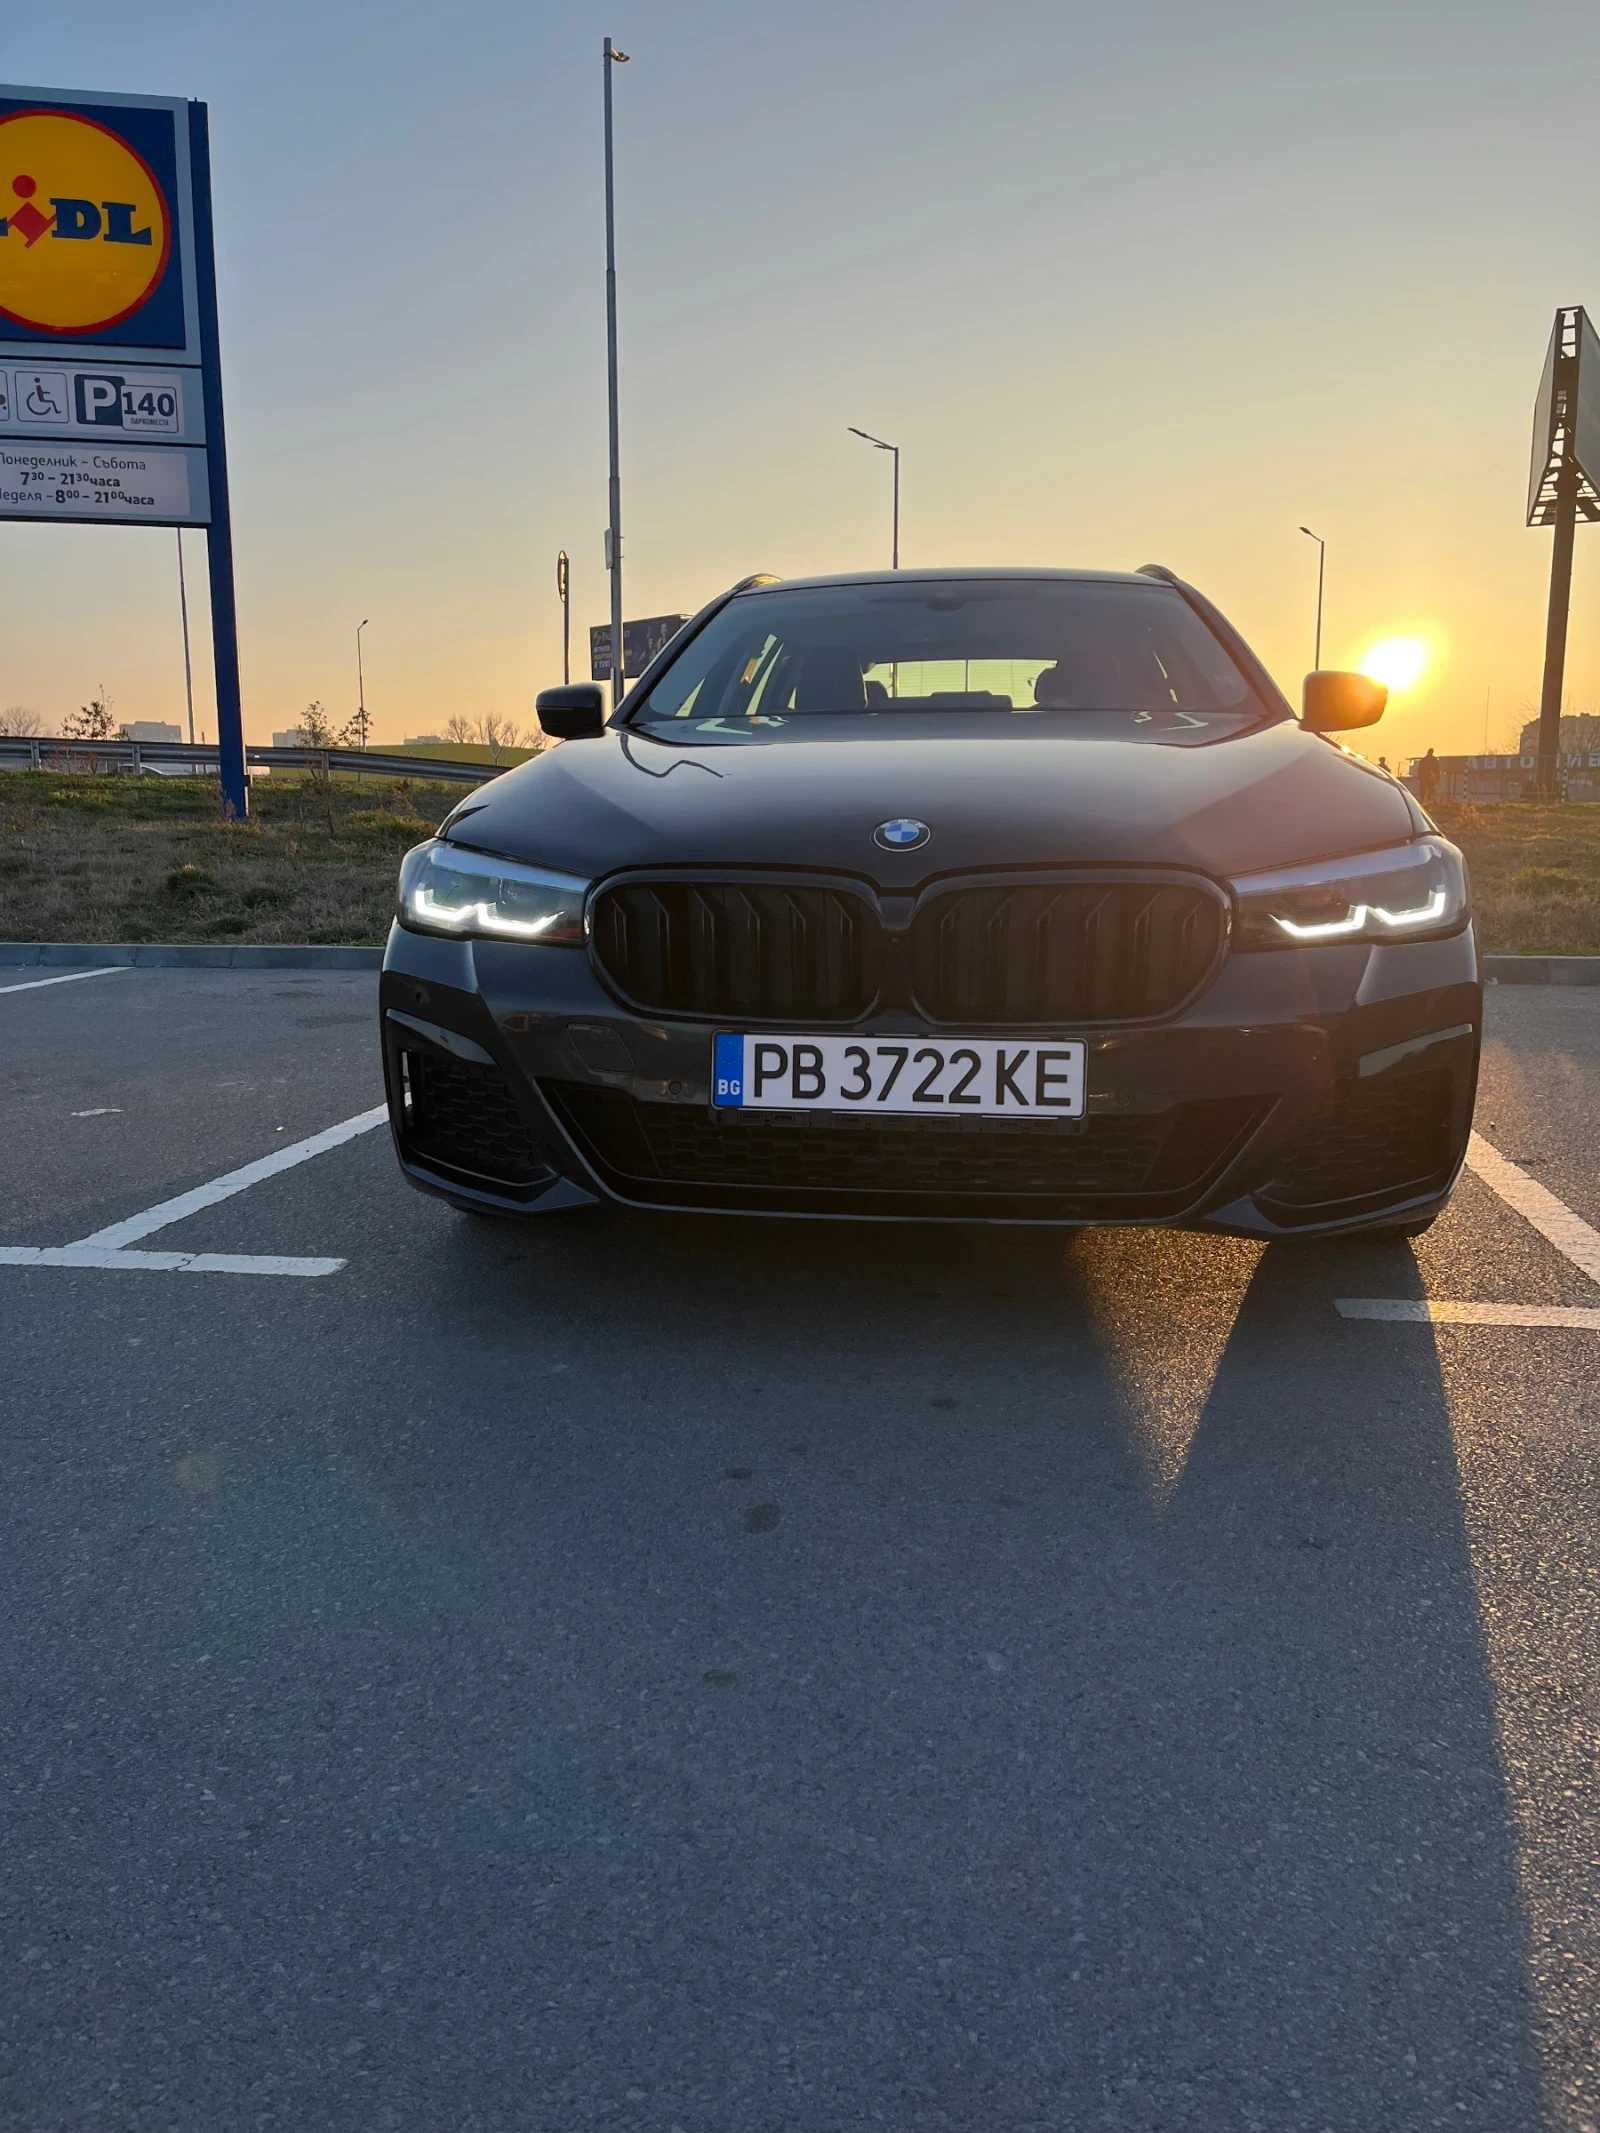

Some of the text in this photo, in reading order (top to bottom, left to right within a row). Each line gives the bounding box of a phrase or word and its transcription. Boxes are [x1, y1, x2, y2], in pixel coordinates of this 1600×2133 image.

[83, 379, 175, 421] P 140
[93, 455, 147, 470] Събота
[717, 1079, 740, 1096] BG
[753, 1043, 1071, 1107] PB 3722 KE
